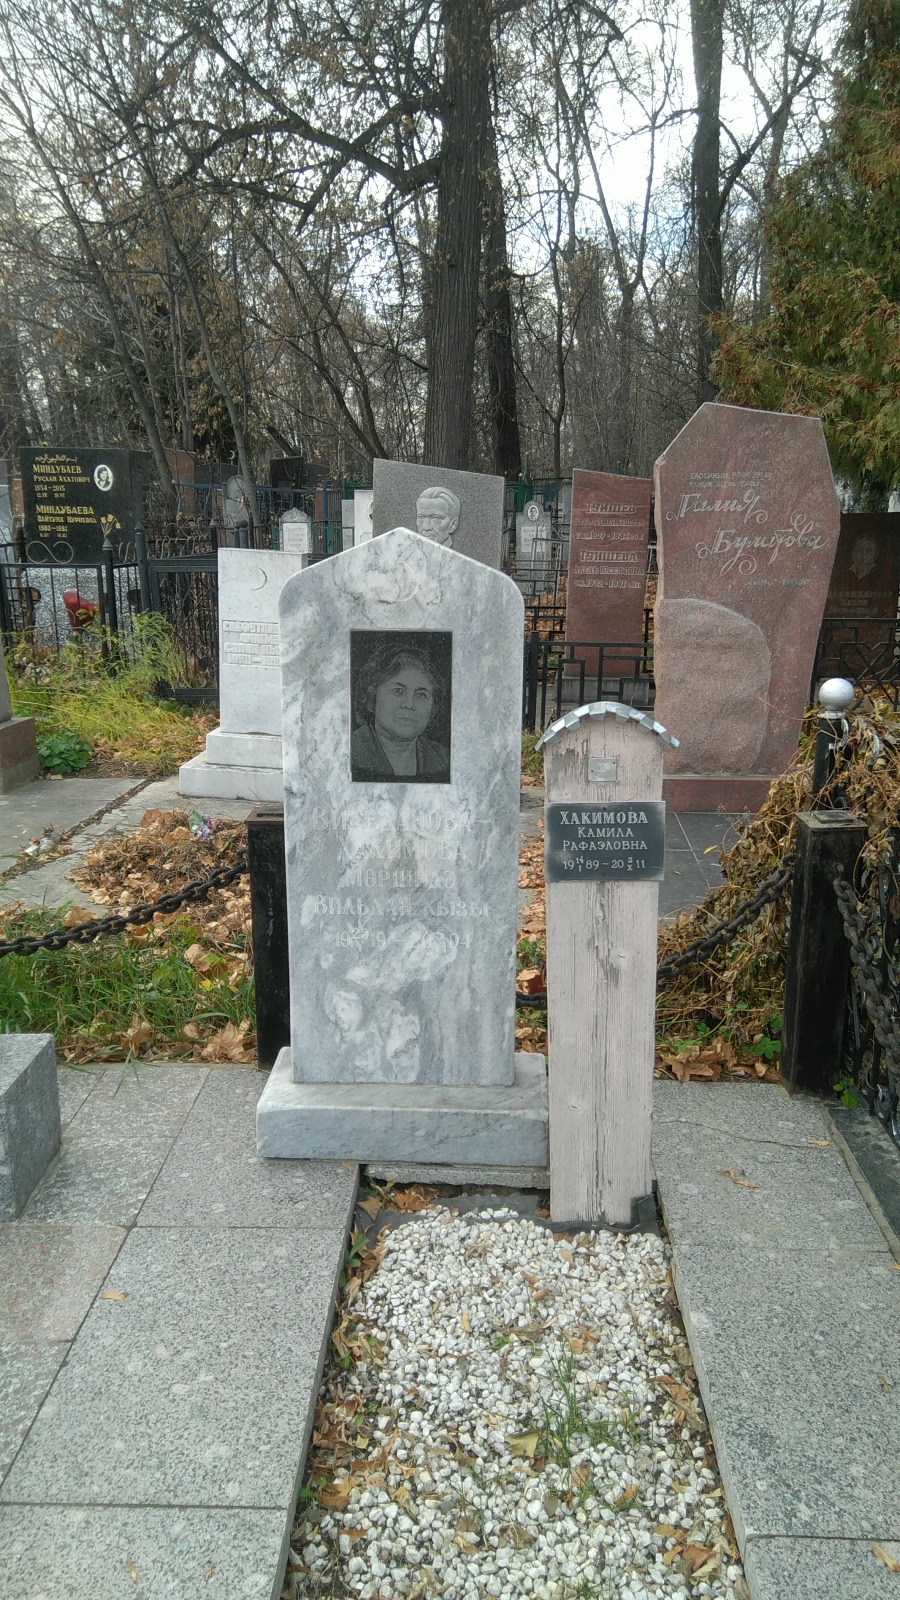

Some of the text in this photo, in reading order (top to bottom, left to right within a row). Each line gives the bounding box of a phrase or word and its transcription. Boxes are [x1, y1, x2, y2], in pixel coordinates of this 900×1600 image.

[32, 464, 82, 473] МИНДУБАЕВ
[36, 505, 94, 514] МИНДУБАЕВА
[665, 489, 768, 524] Галия
[695, 509, 828, 577] Булатова
[579, 549, 638, 563] ТУИШЕВА
[559, 811, 648, 825] ХАКИМОВА
[577, 826, 634, 838] КАМИЛА
[562, 840, 648, 851] РАФАЭЛОВНА
